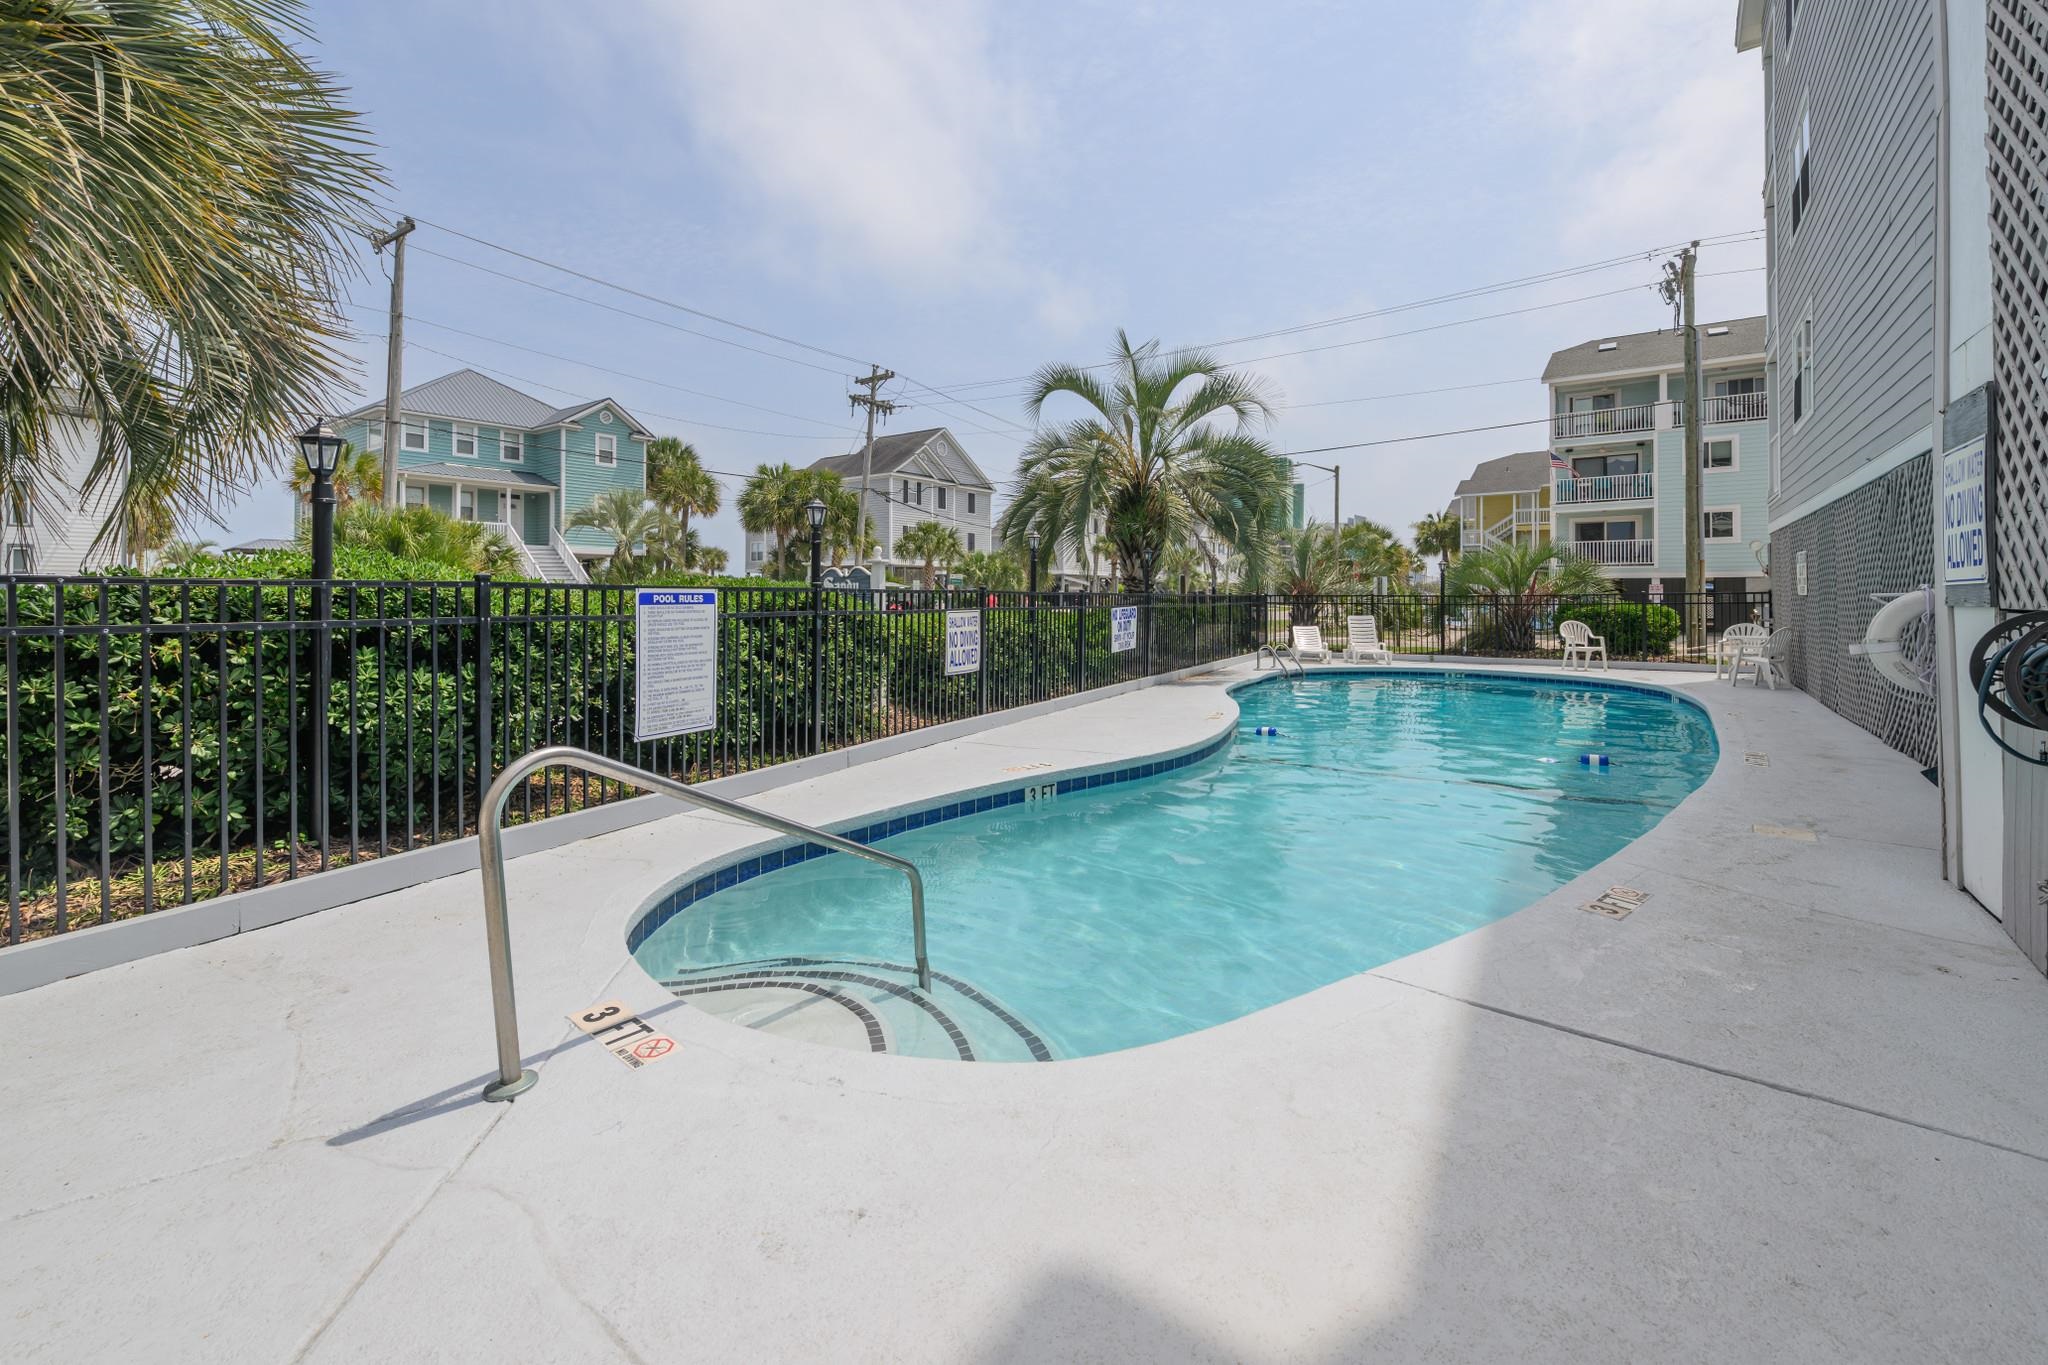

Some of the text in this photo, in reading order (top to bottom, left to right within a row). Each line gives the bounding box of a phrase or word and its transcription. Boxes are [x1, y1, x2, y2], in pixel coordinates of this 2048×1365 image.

[1945, 450, 1983, 488] SHALLOW WATER
[1945, 484, 1983, 530] NO DIVING
[1947, 528, 1983, 569] ALLOWED
[653, 594, 704, 603] POOL RULES
[948, 630, 978, 648] NO DIVING
[949, 648, 978, 667] ALLOWED
[1030, 784, 1055, 800] 3 FT
[583, 1006, 655, 1045] 3 FT
